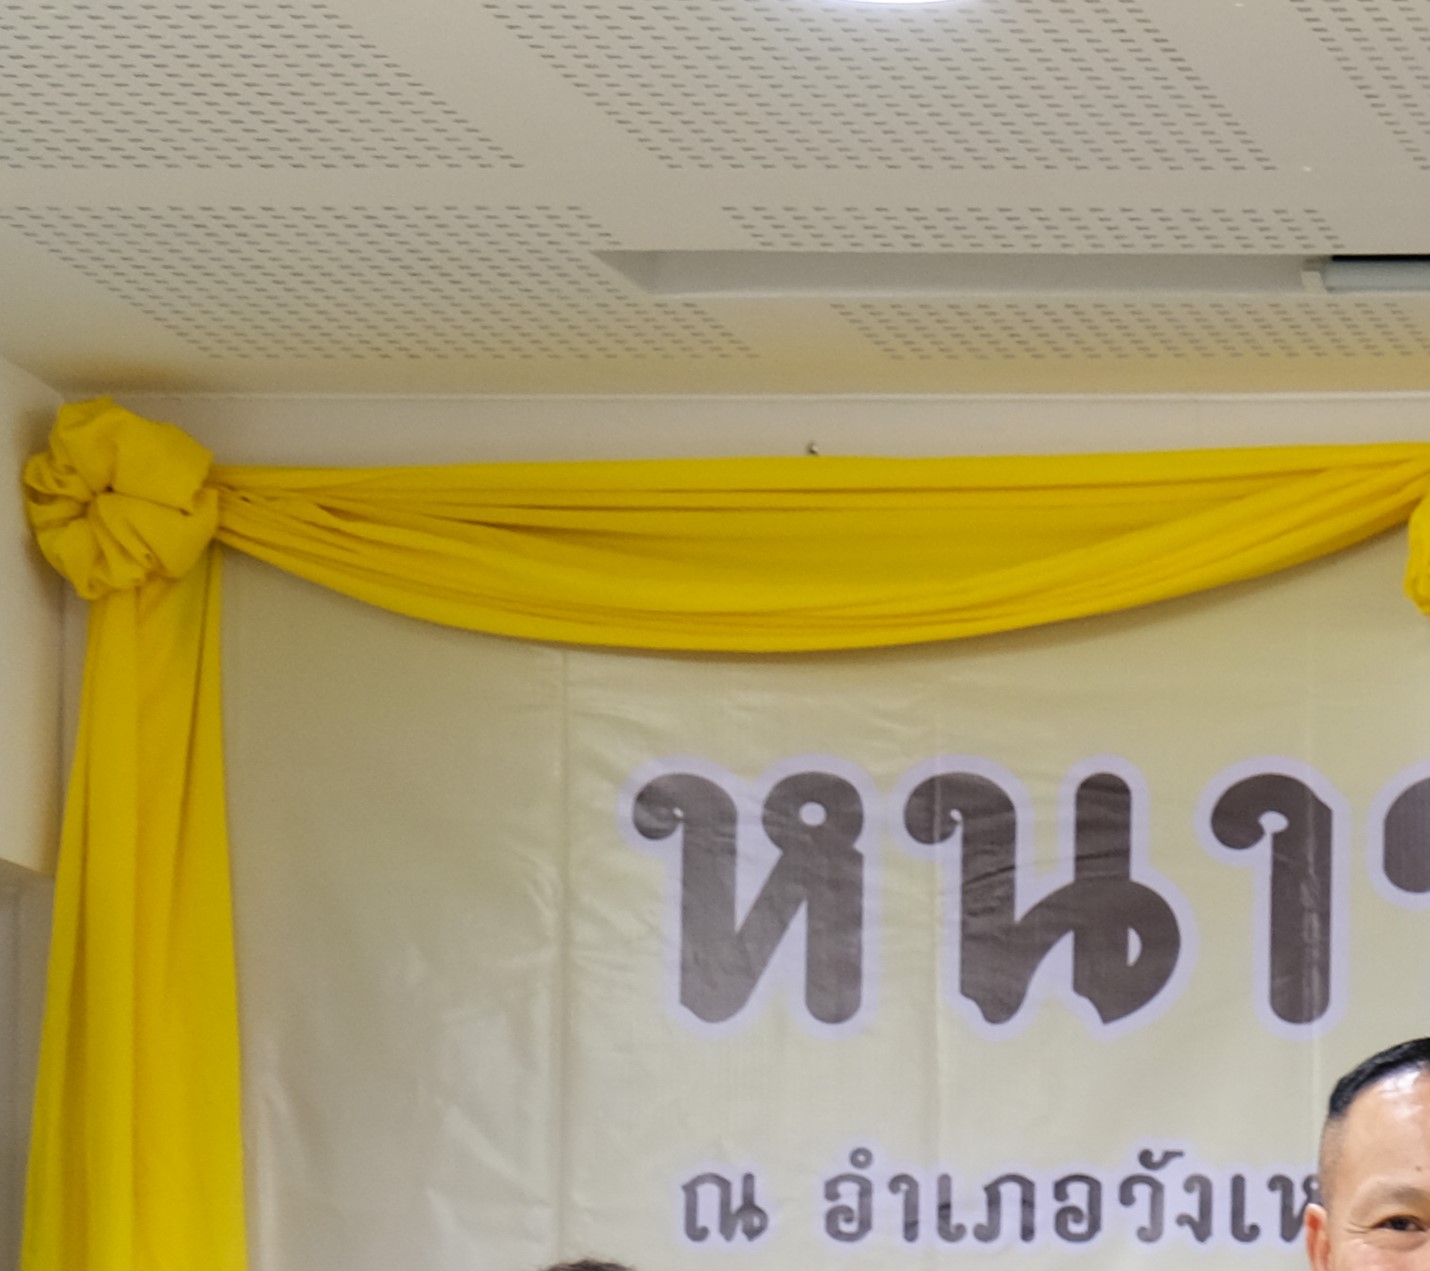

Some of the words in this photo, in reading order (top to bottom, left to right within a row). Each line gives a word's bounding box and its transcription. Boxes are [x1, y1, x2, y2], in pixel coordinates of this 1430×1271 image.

[682, 1172, 768, 1244] ณ
[823, 1147, 1322, 1244] อำเภอวังเห
